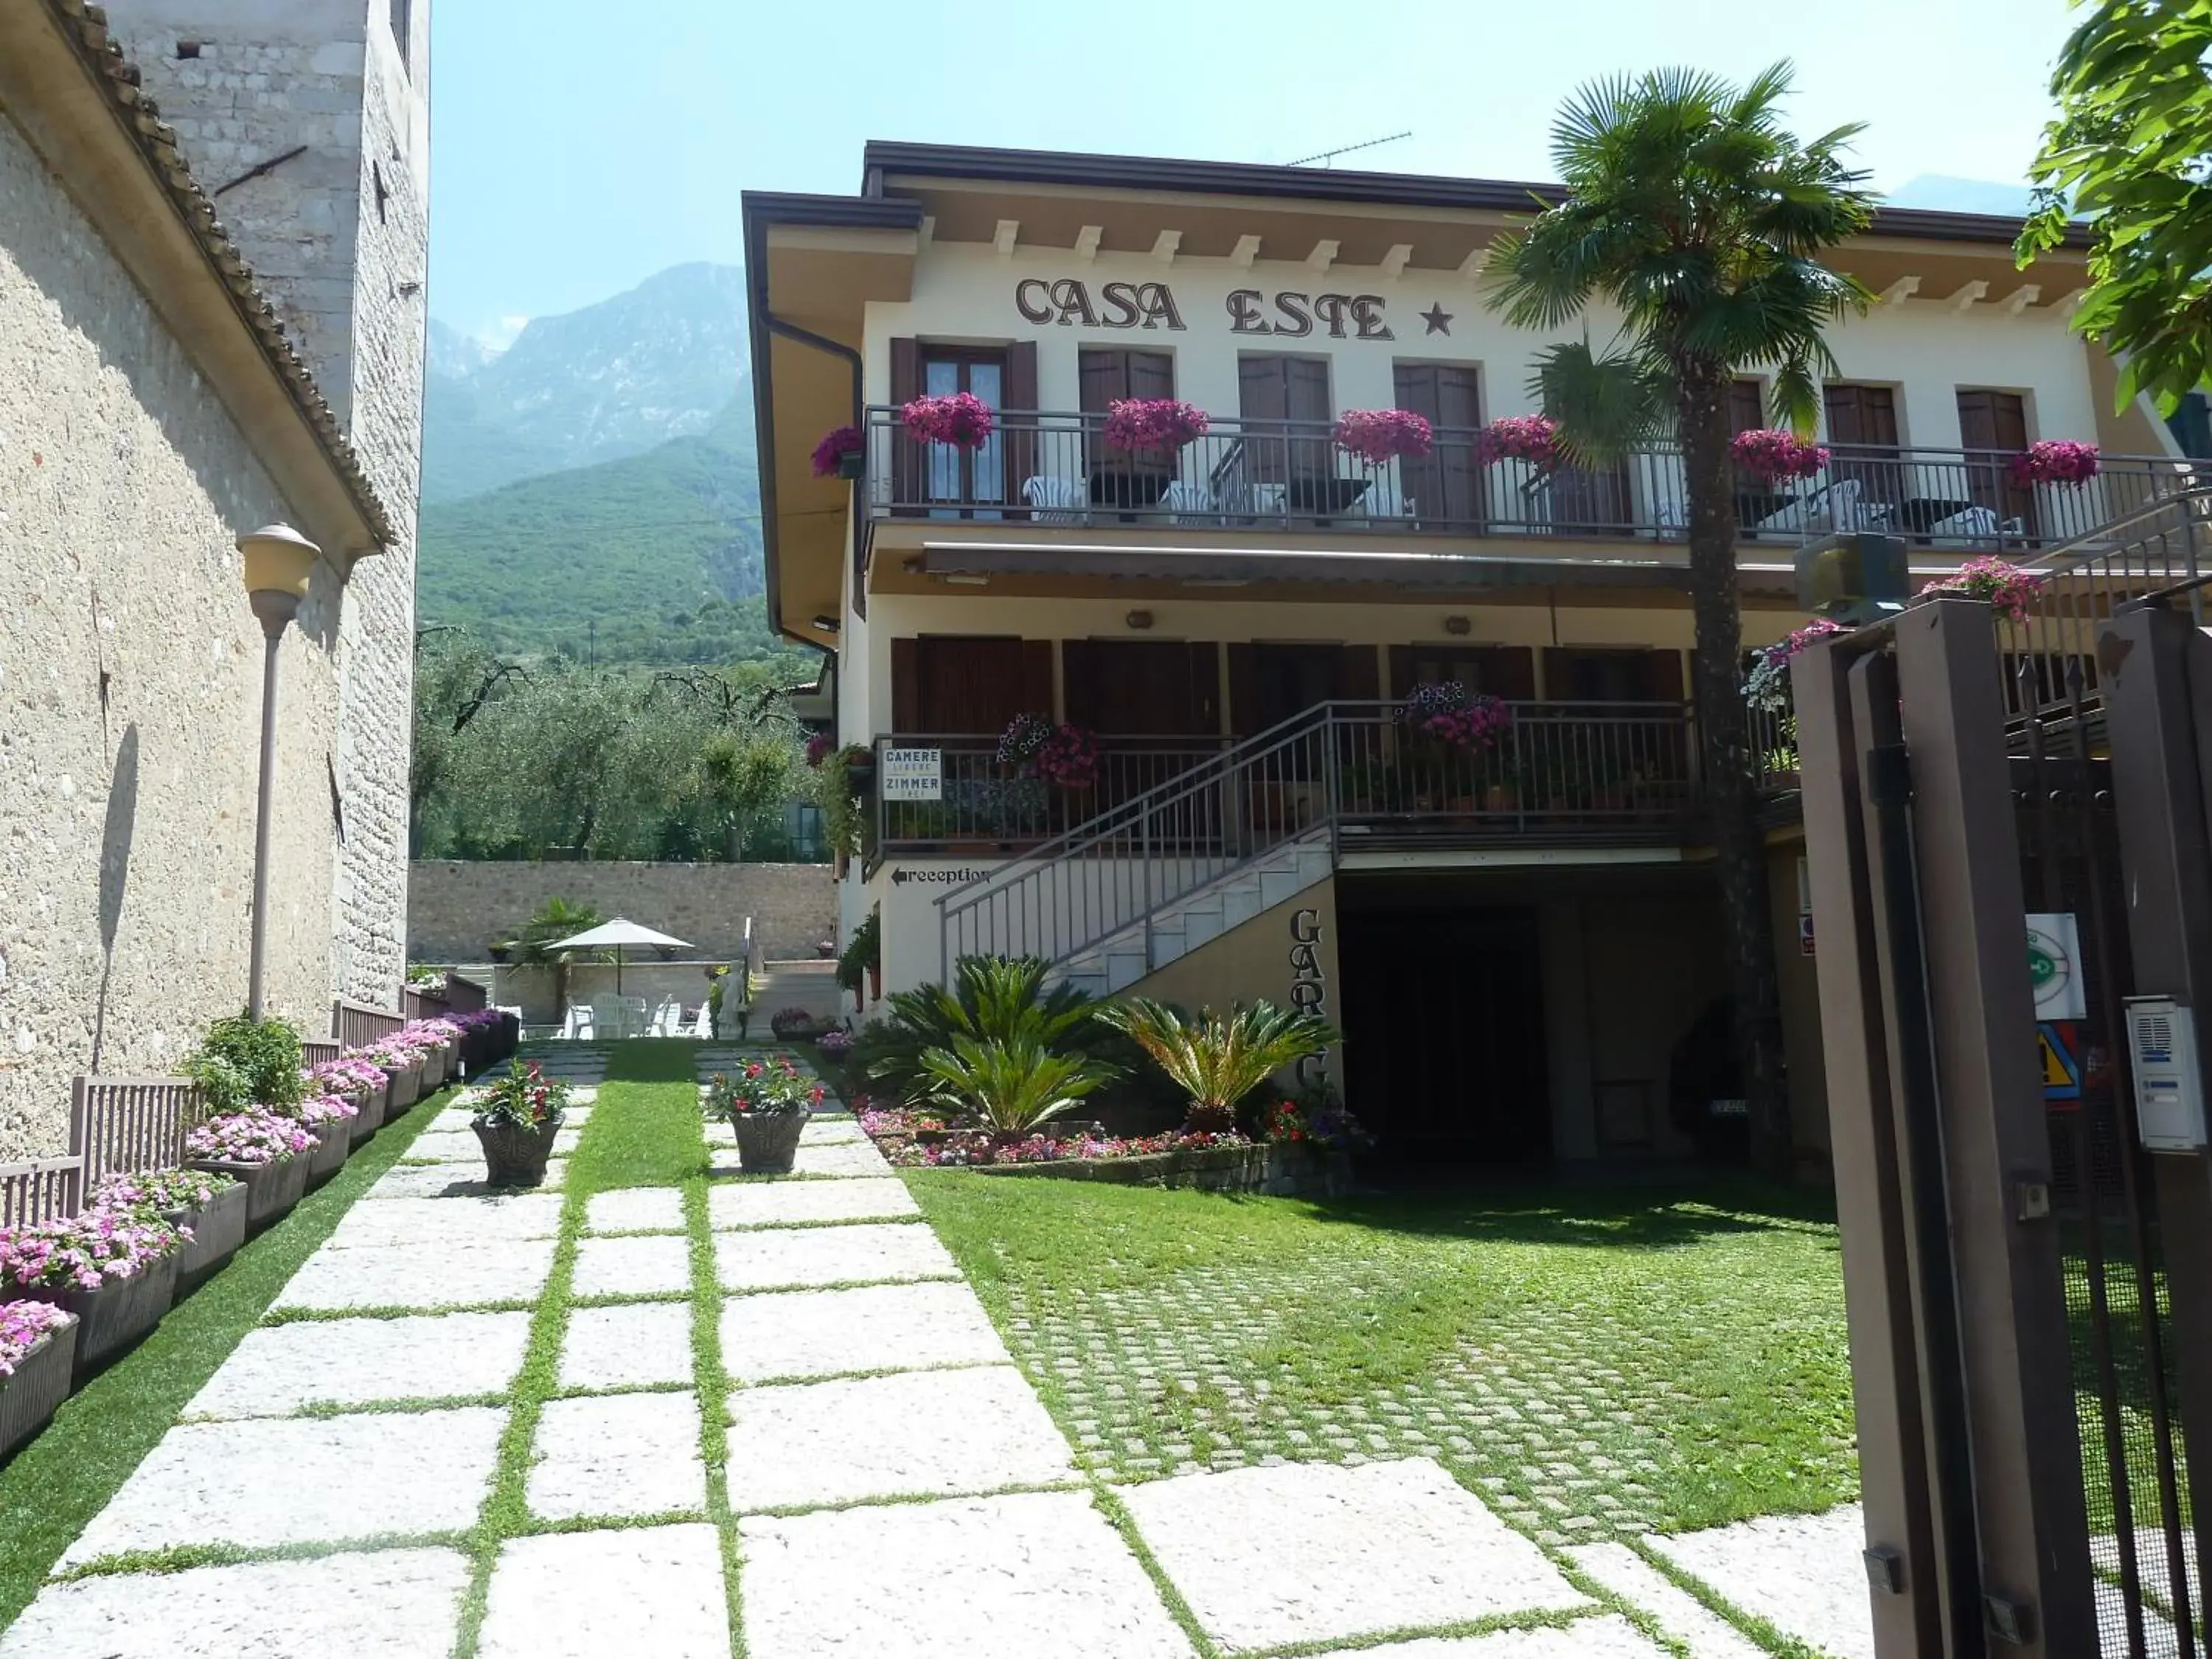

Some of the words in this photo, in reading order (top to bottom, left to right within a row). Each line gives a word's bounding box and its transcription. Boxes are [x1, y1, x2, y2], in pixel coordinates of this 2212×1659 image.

[1015, 279, 1187, 330] CASA
[1226, 289, 1395, 341] ESTE
[886, 751, 939, 762] CAMERE
[886, 778, 939, 788] ZIMMER
